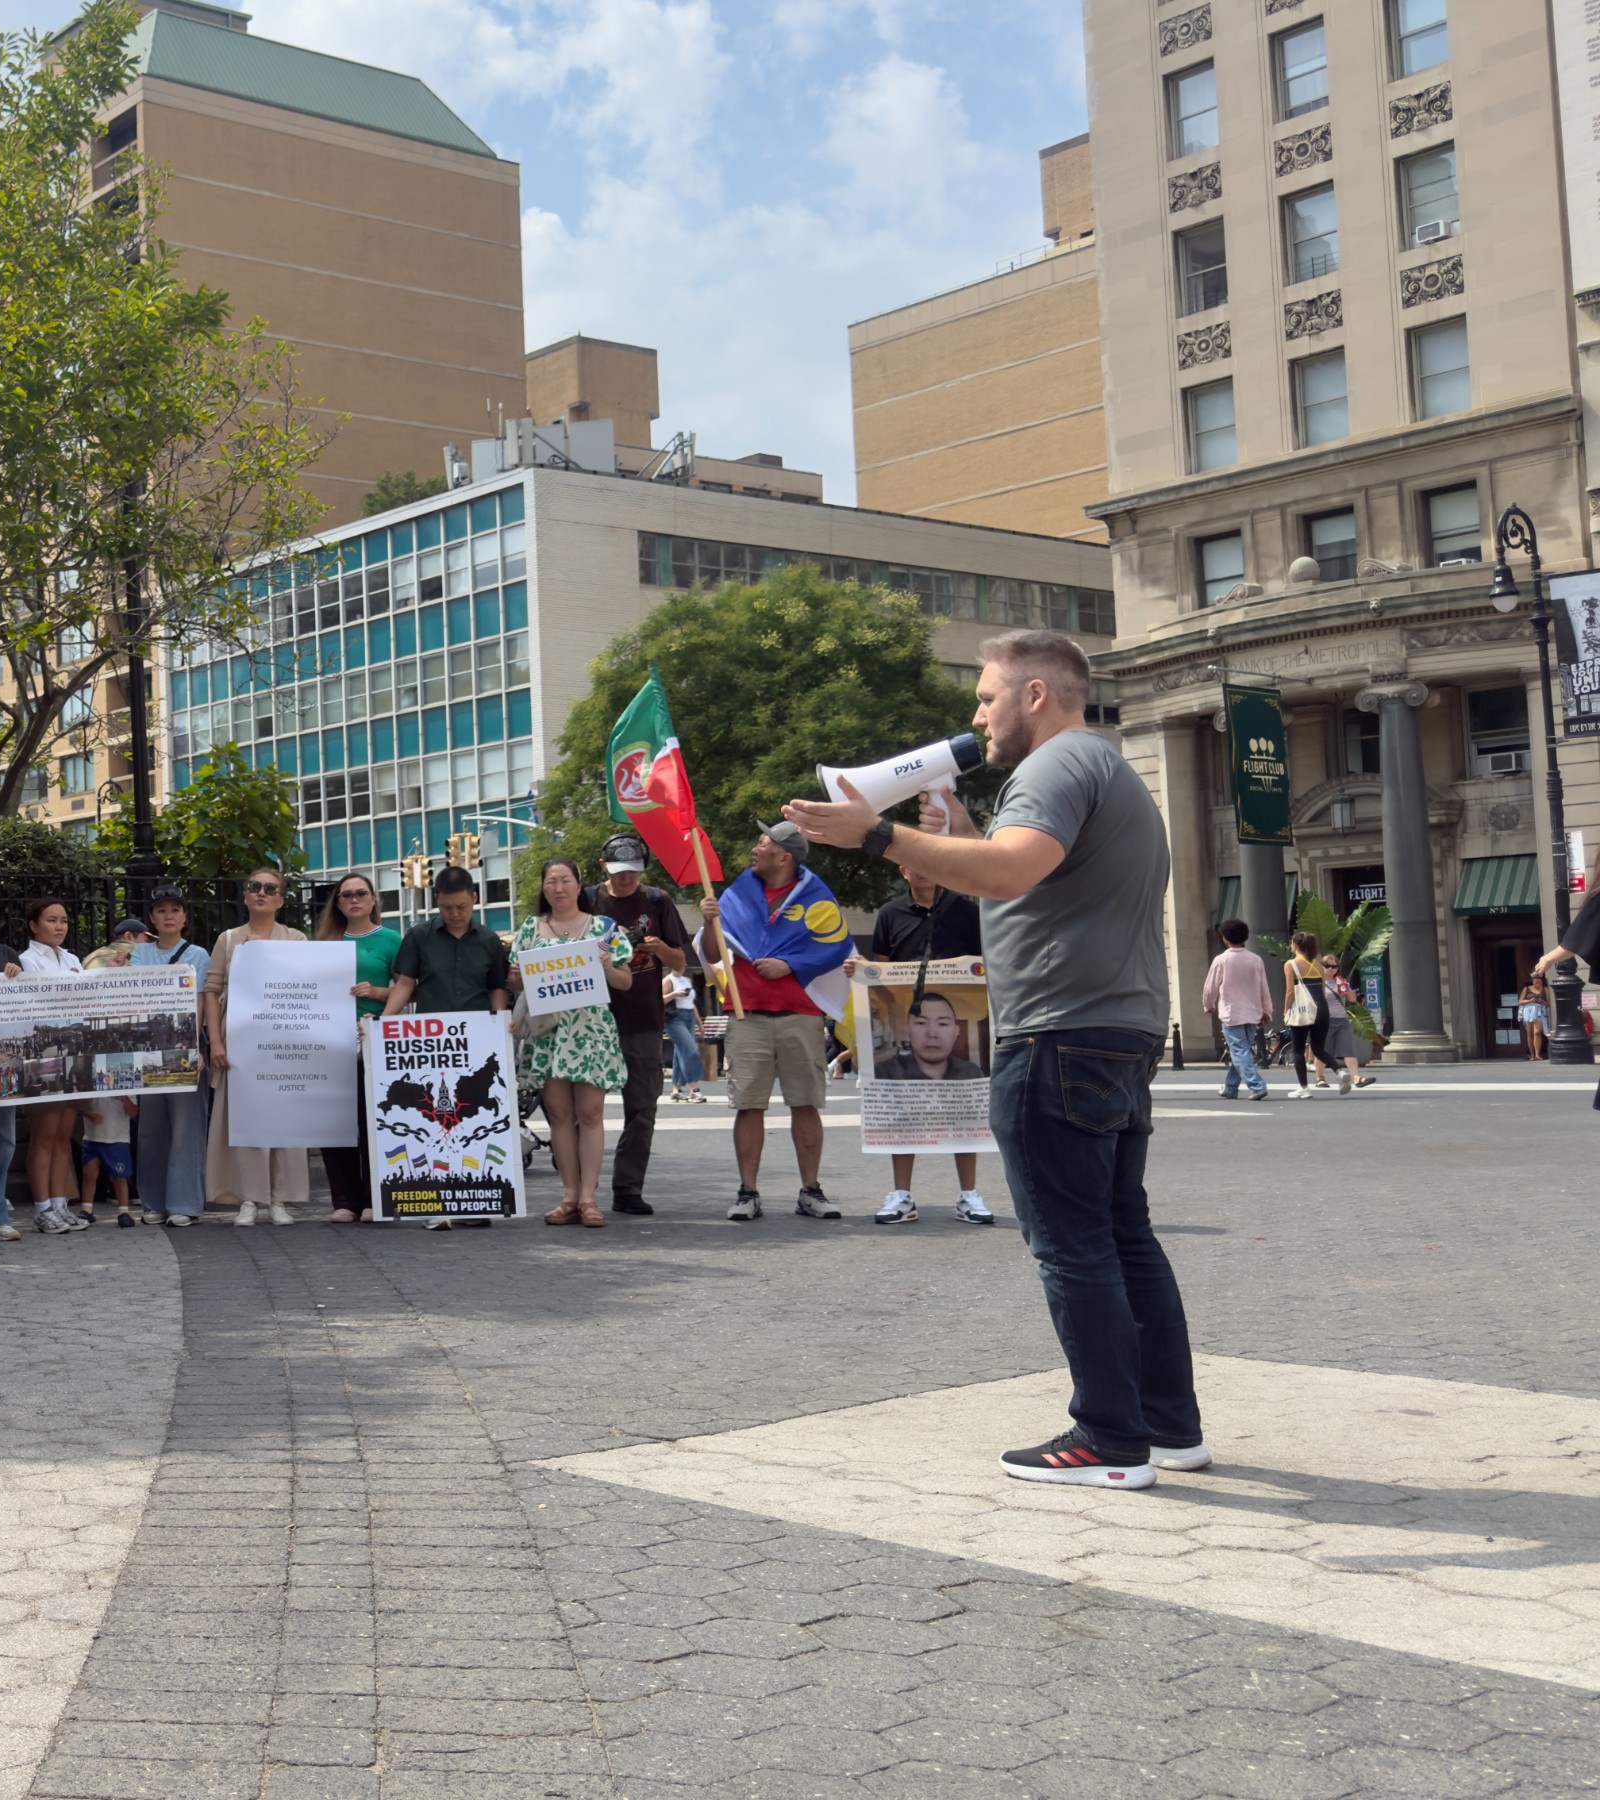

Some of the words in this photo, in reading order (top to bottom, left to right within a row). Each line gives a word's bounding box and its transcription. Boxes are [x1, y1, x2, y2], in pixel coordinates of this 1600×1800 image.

[1263, 655, 1280, 673] OF
[1281, 653, 1306, 670] THE
[1308, 640, 1399, 666] METROPOLIS
[894, 759, 923, 776] PYLE
[1243, 760, 1268, 774] FLIGHT
[1269, 762, 1285, 775] CLUB
[524, 955, 586, 976] RUSSIA
[41, 984, 53, 993] OF
[55, 983, 72, 992] THE
[74, 979, 139, 991] OIRAT-KALMYK
[141, 977, 174, 987] PEOPLE
[537, 978, 594, 999] STATE!!
[382, 1019, 444, 1039] END
[447, 1021, 467, 1036] of
[384, 1038, 468, 1054] RUSSIAN
[385, 1053, 469, 1071] EMPIRE!
[278, 1084, 306, 1092] JUSTICE
[391, 1190, 437, 1201] FREEDOM
[439, 1190, 452, 1200] TO
[455, 1189, 502, 1200] NATIONS!
[397, 1202, 443, 1212] FREEDOM
[444, 1202, 458, 1211] TO
[460, 1201, 501, 1211] PEOPLE!
